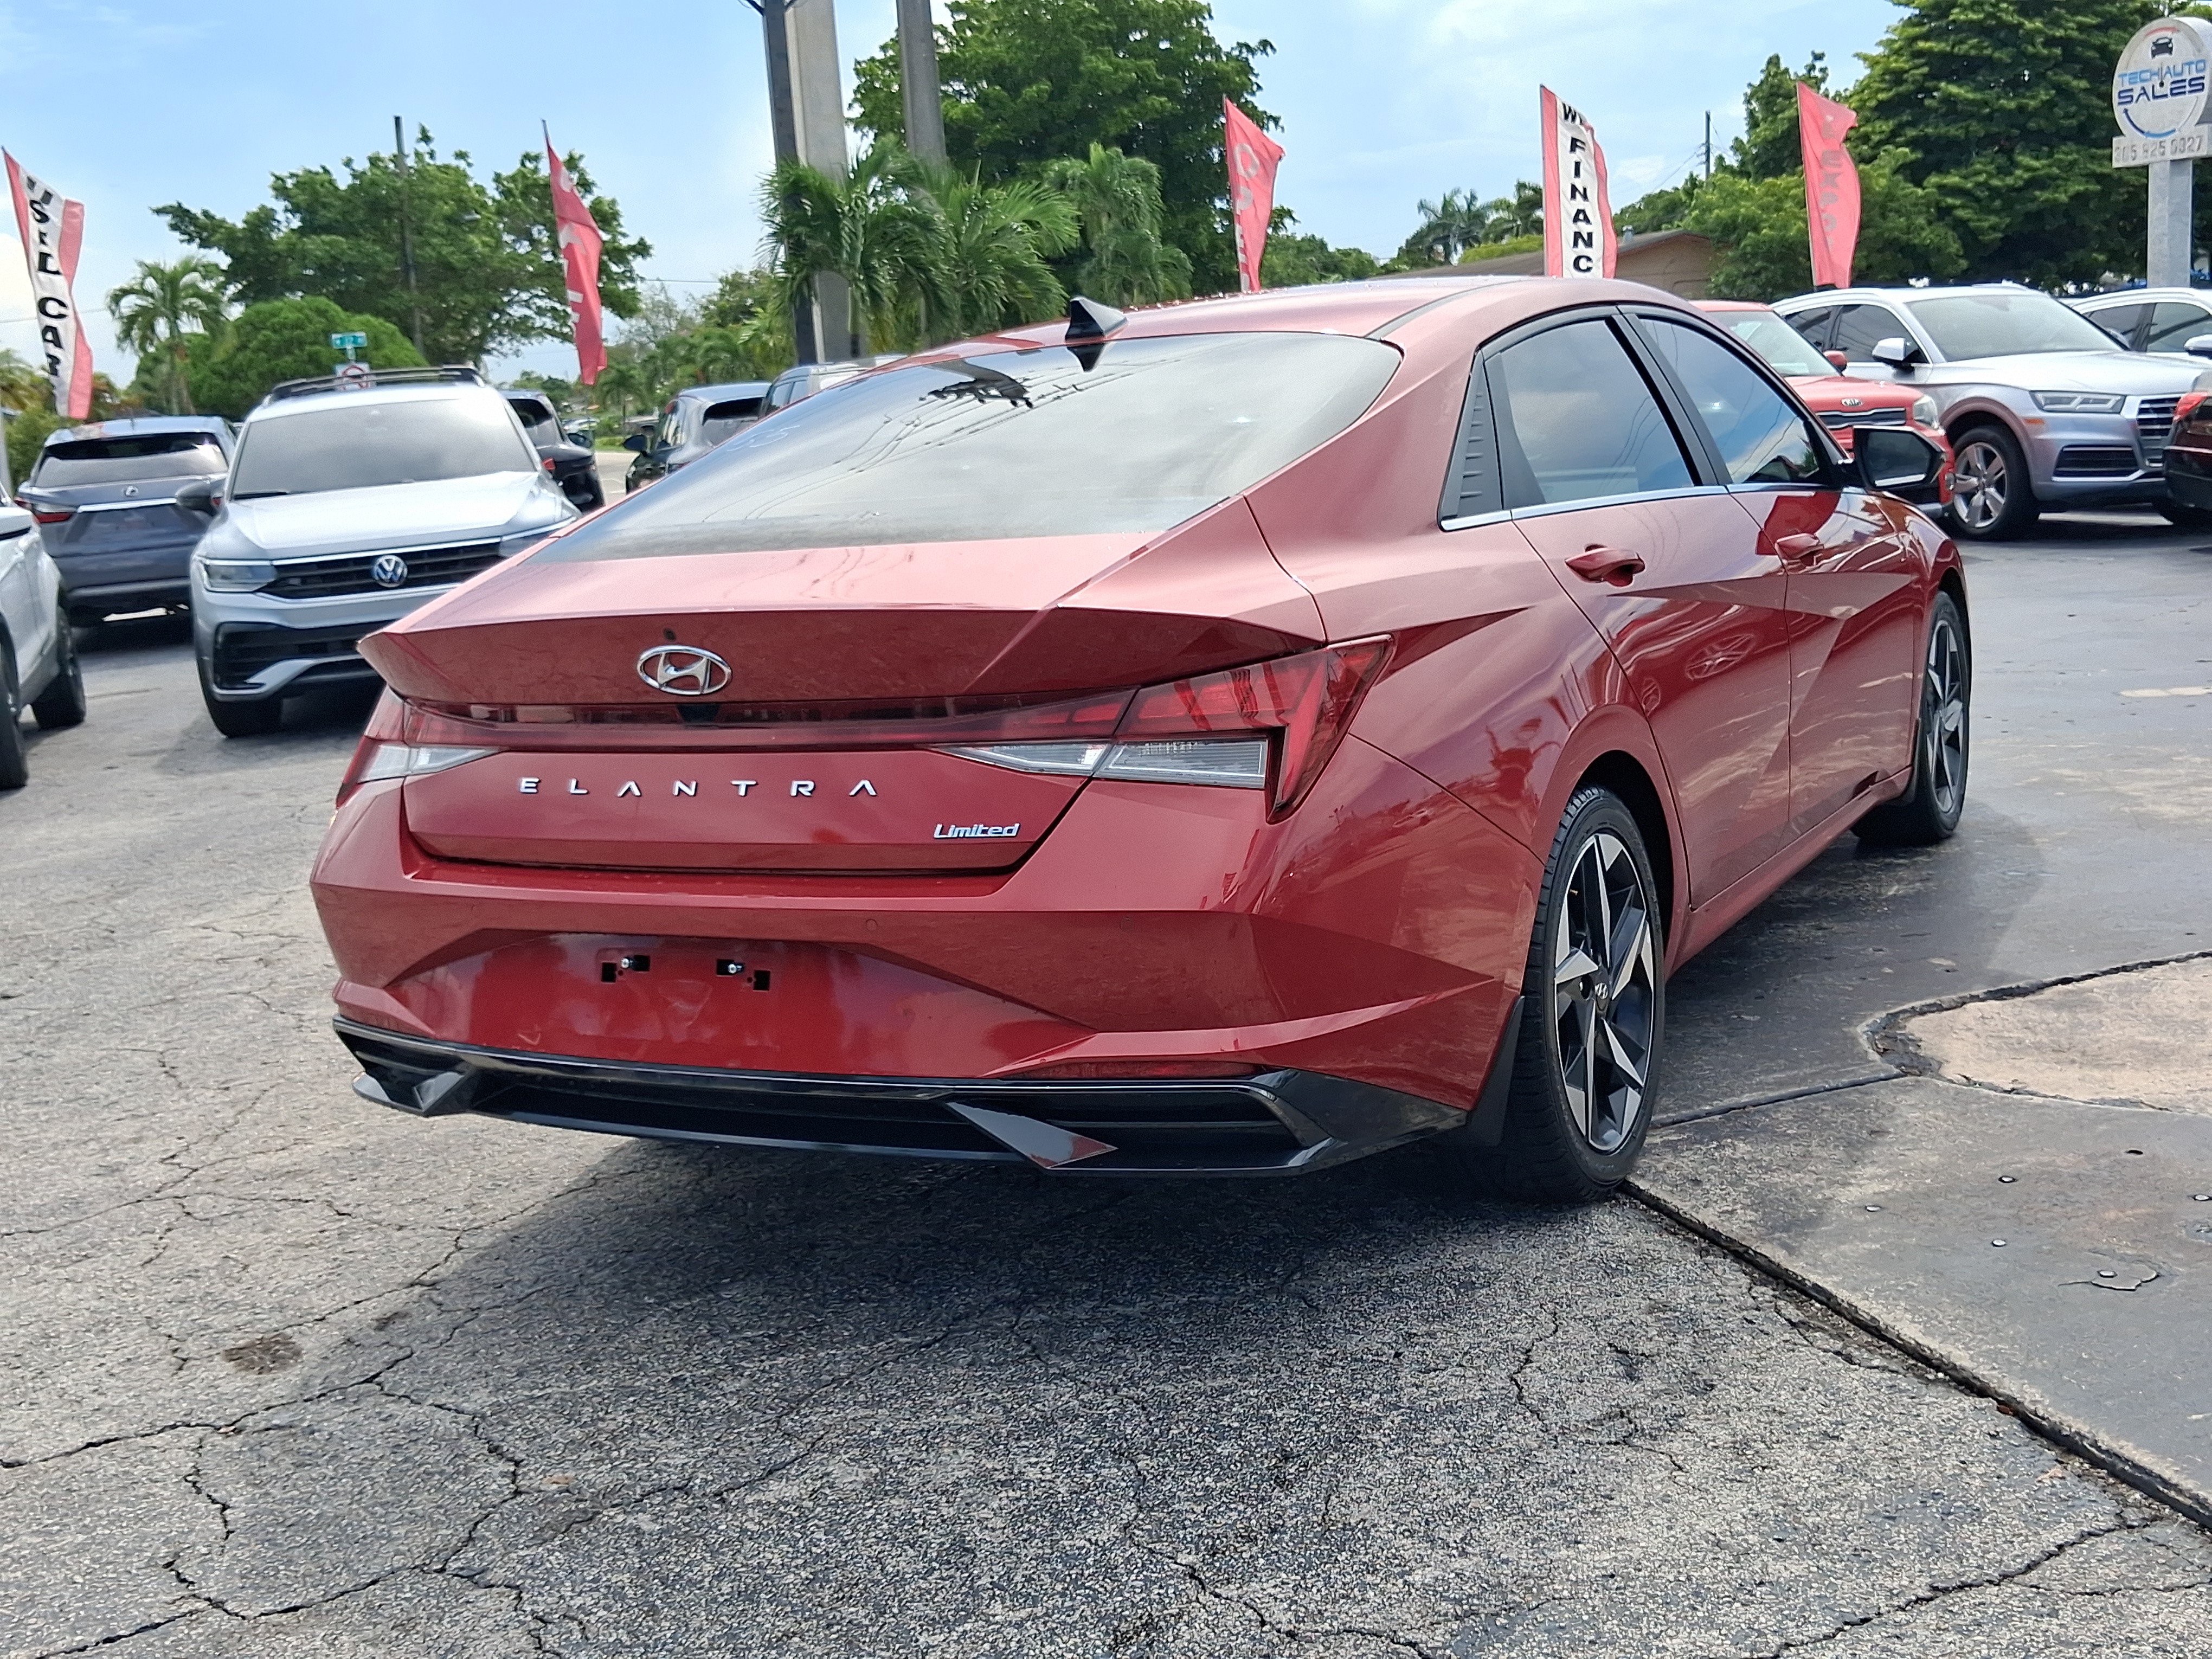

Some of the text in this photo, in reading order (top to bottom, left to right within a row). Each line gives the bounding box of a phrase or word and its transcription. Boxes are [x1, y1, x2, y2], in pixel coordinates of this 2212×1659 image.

[2118, 75, 2205, 105] SALES
[519, 777, 878, 798] ELANTRA
[934, 823, 1020, 839] Limited
